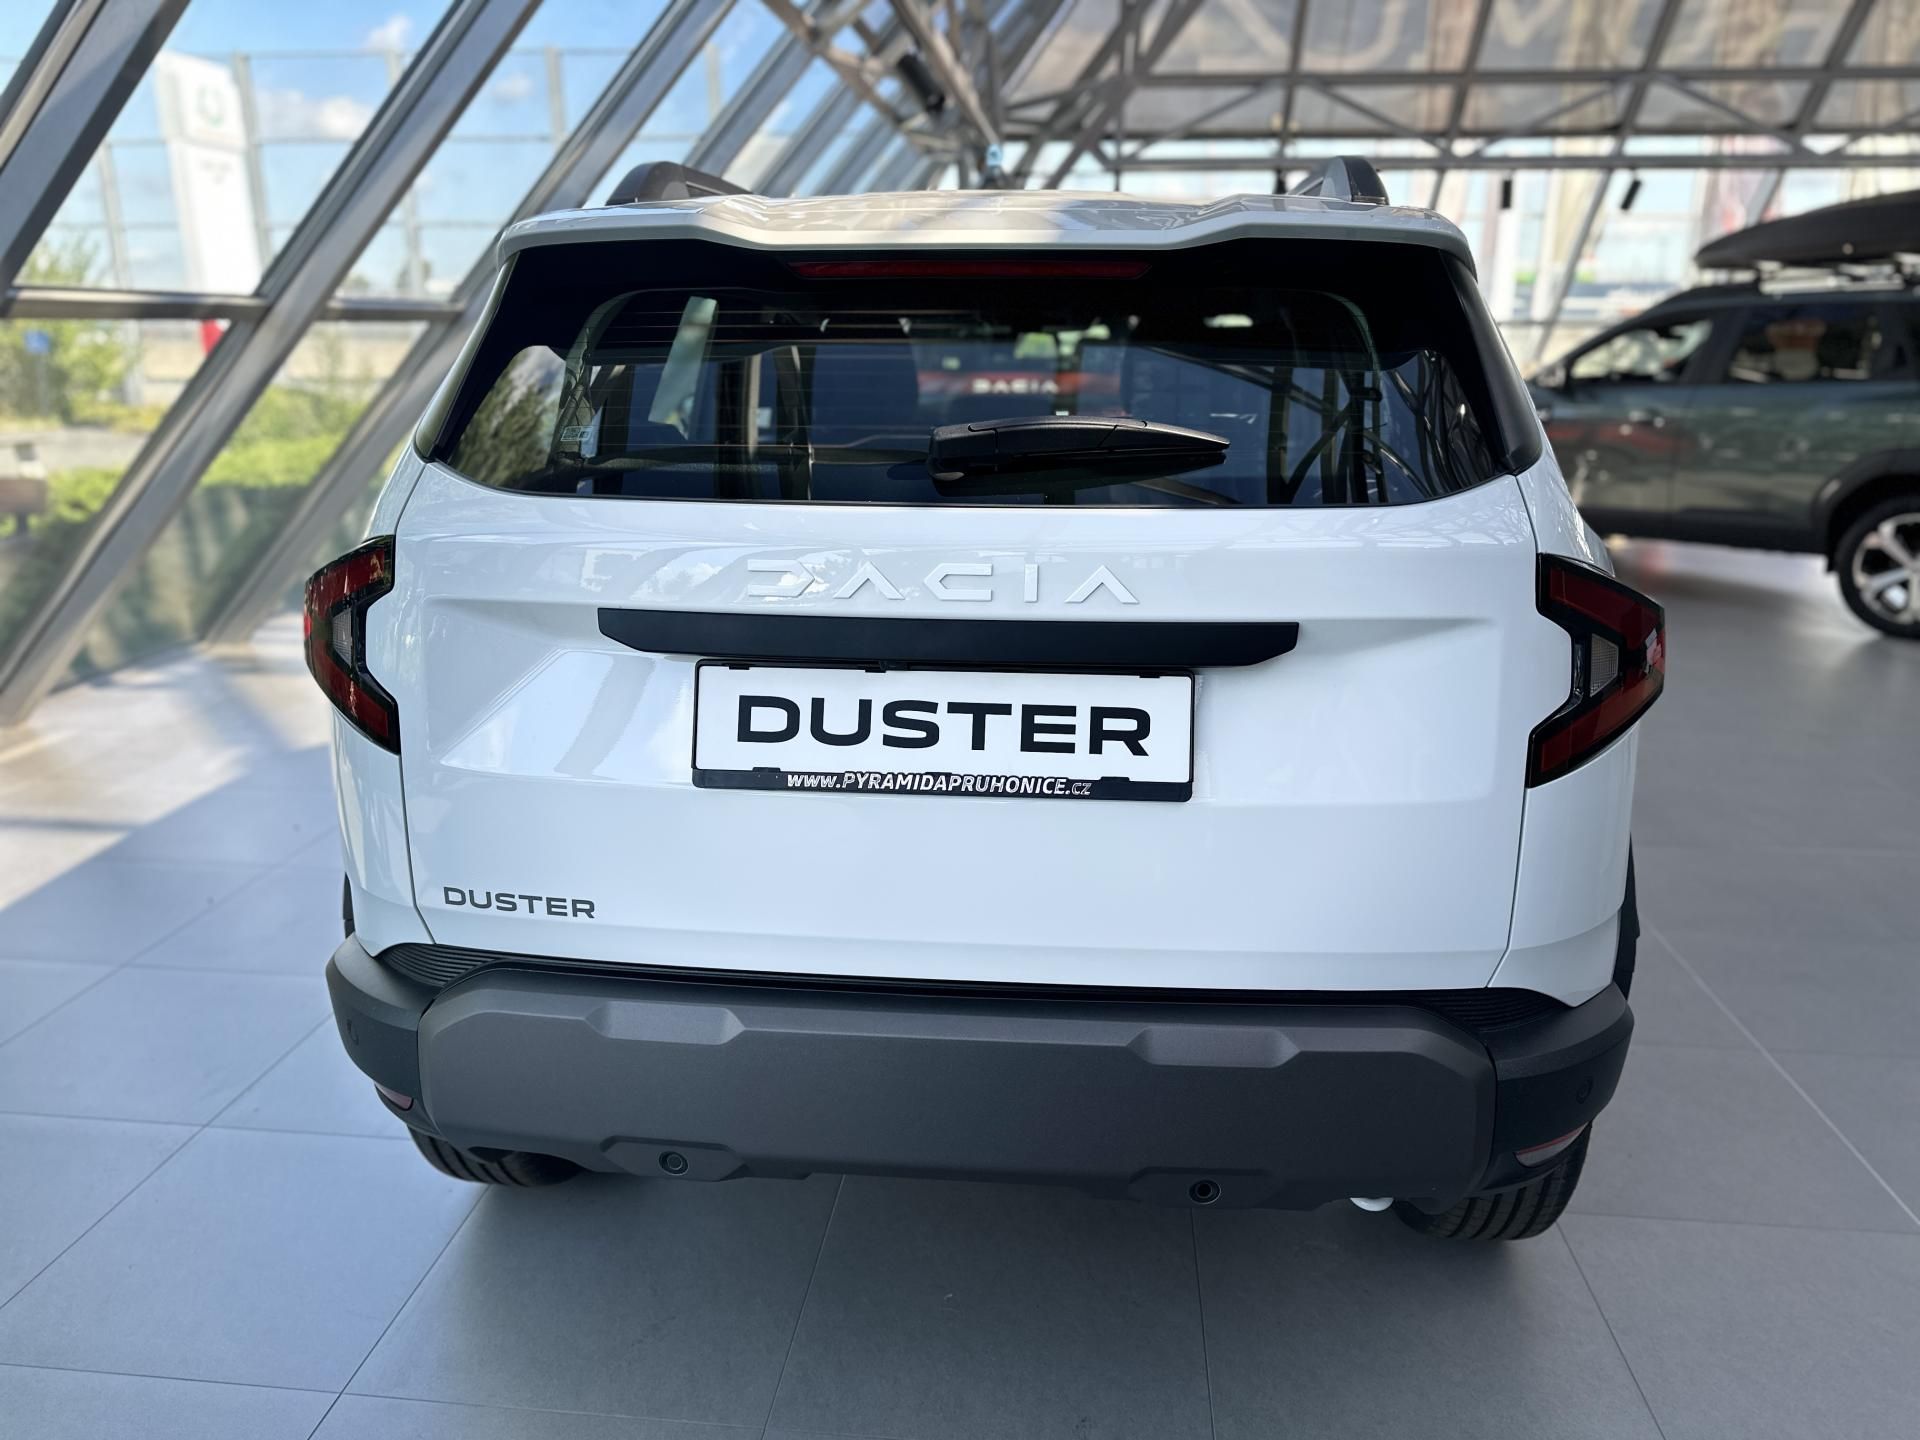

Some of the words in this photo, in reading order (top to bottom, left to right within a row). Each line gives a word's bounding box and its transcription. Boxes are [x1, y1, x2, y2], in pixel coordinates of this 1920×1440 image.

[747, 560, 1139, 604] DACIA
[737, 694, 1151, 756] DUSTER
[443, 886, 595, 919] DUSTER
